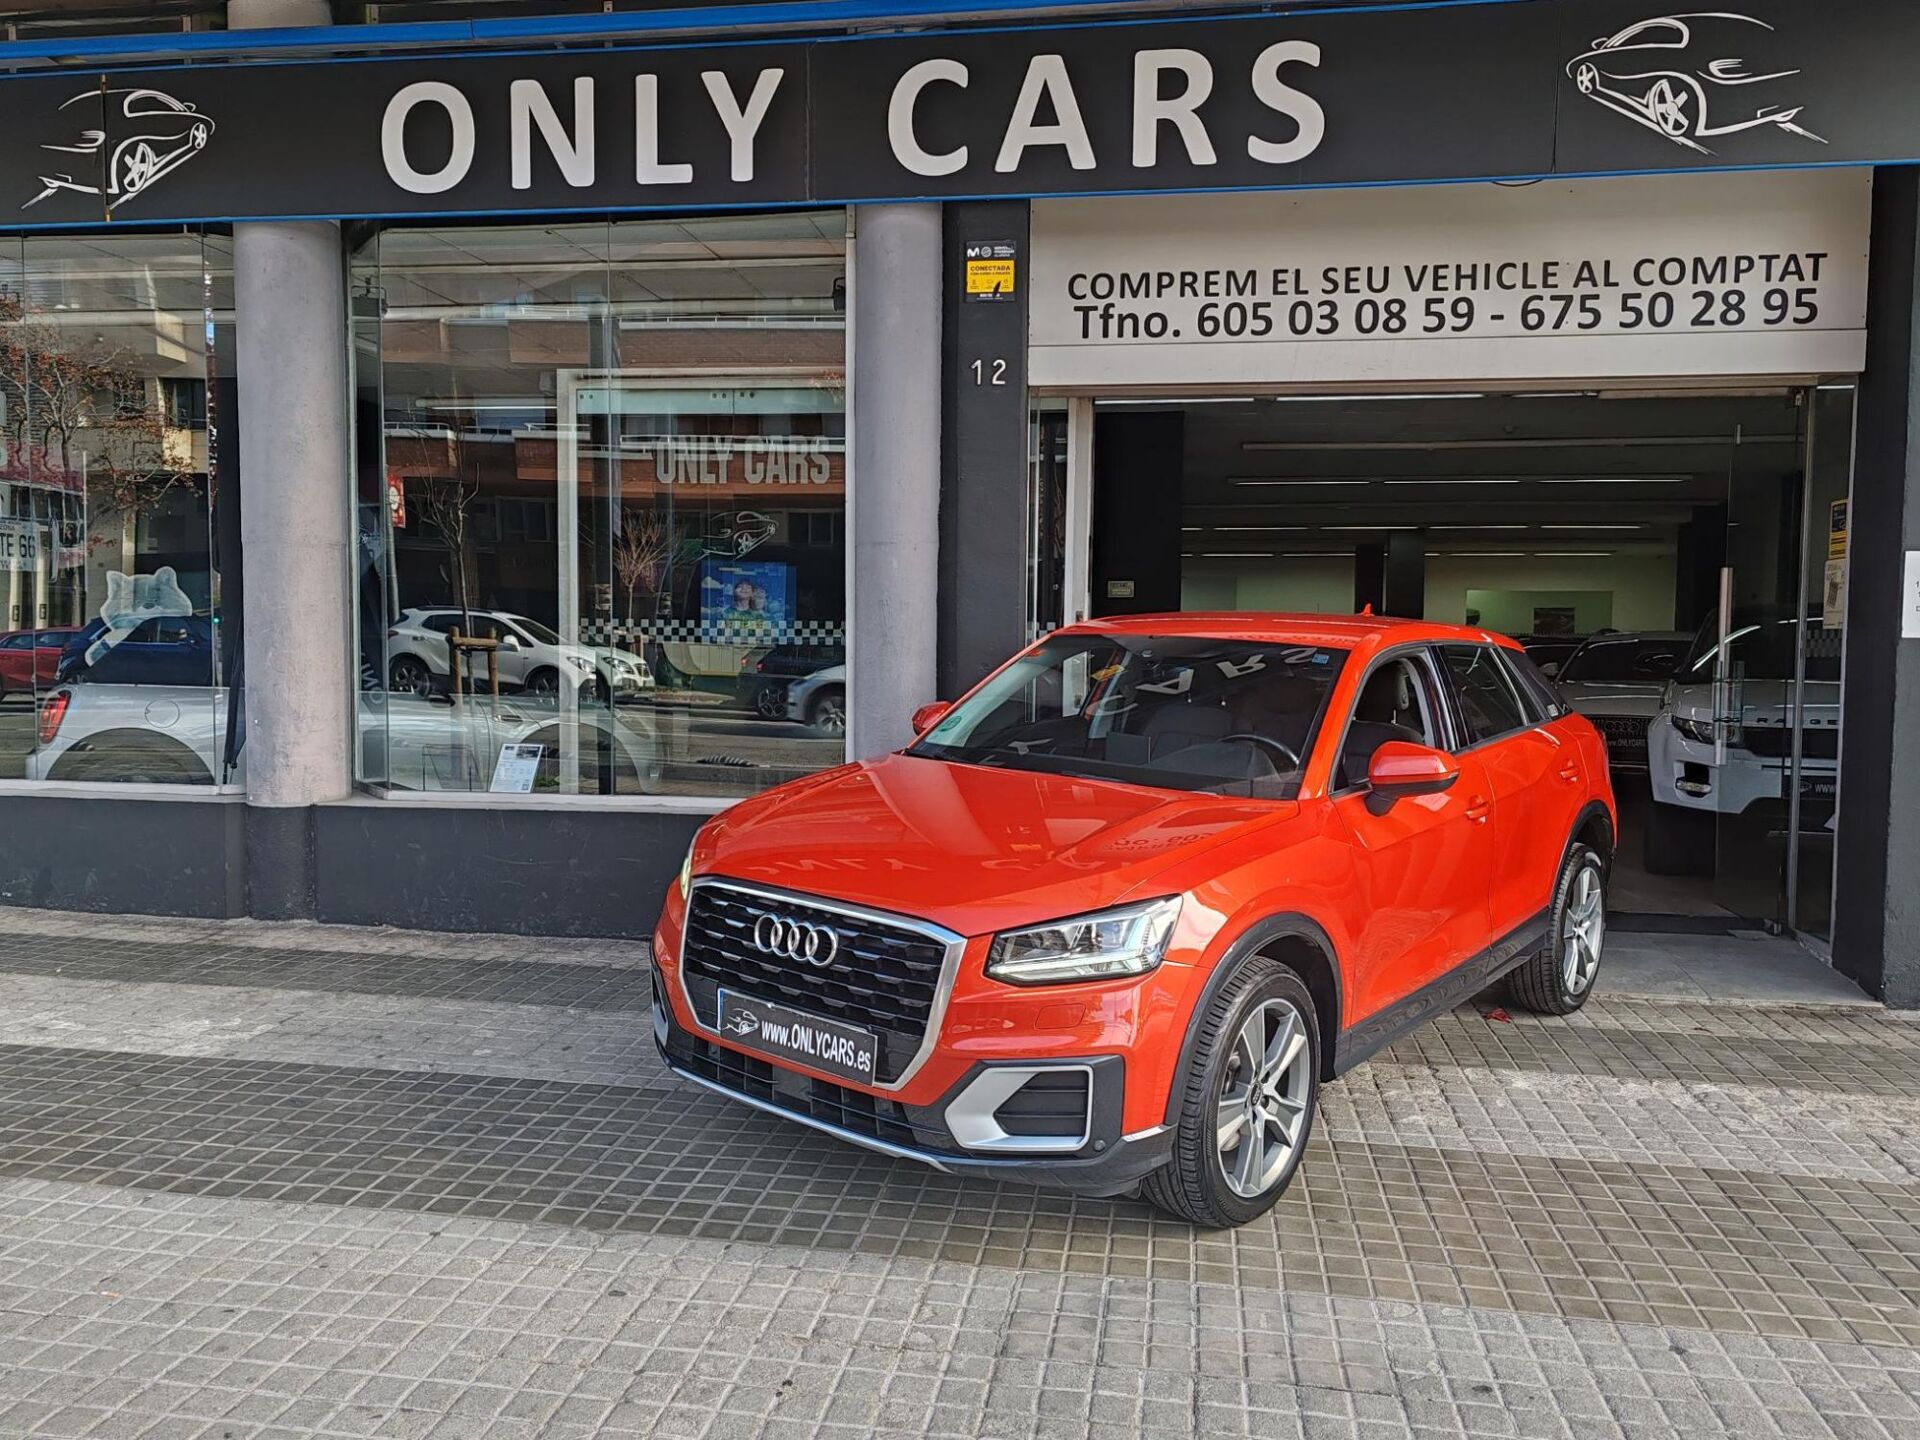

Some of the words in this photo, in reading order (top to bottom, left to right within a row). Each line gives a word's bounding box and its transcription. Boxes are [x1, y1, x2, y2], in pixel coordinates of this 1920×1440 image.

[381, 68, 785, 194] ONLY
[887, 40, 1326, 177] CARS
[1067, 270, 1258, 300] COMPREM
[1271, 268, 1310, 296] EL
[1320, 265, 1391, 294] SEU
[1403, 260, 1560, 293] VEHICLE
[1572, 259, 1620, 288] AL
[1632, 252, 1828, 287] COMPTAT
[1073, 303, 1181, 339] Tfno.
[1197, 301, 1273, 337] 605
[1288, 299, 1339, 336] 03
[1354, 298, 1407, 334] 08
[1422, 297, 1475, 333] 59
[1520, 293, 1602, 331] 675
[1619, 291, 1674, 329] 50
[1690, 289, 1746, 327] 28
[1763, 287, 1819, 325] 95
[970, 358, 1008, 386] 12
[656, 437, 733, 484] ONLY
[744, 437, 830, 484] CARS
[19, 534, 36, 559] 66
[761, 1020, 871, 1073] www.ONLYCARS.es
